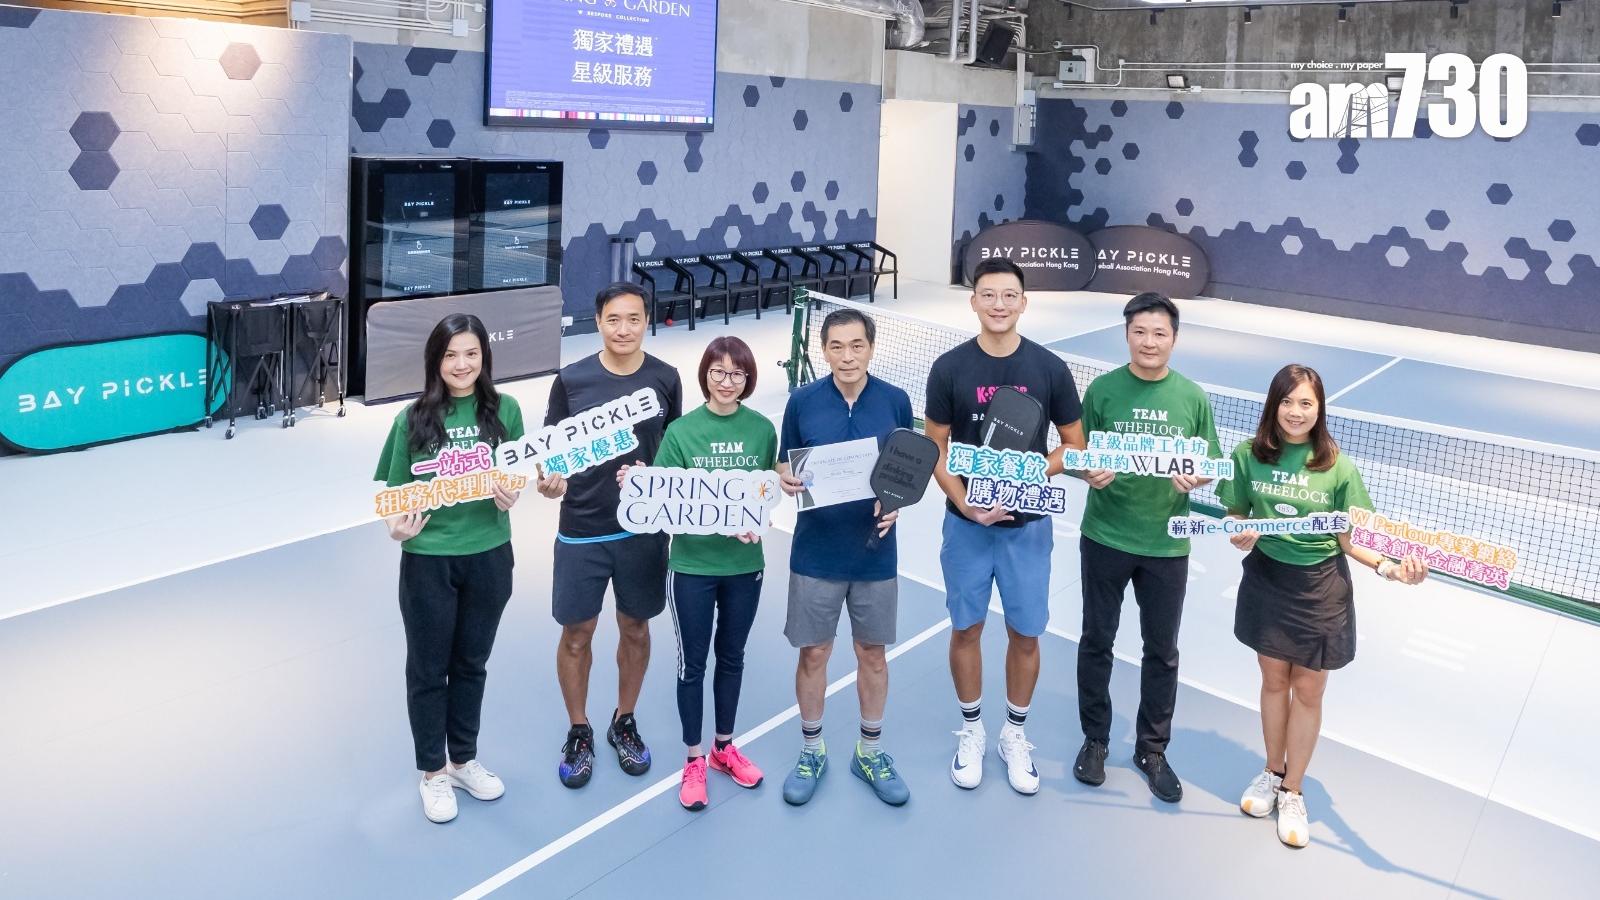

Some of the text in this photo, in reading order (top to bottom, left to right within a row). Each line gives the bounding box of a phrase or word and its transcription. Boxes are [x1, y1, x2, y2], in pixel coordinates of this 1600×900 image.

[624, 0, 691, 17] GARDEN
[615, 14, 650, 23] COLLECTION
[572, 28, 654, 57] 獨家禮遇
[571, 61, 653, 88] 星級服務
[982, 247, 1014, 259] BAY
[1097, 249, 1120, 261] AY
[1046, 261, 1062, 270] Hong
[1063, 261, 1079, 270] Kong
[1115, 263, 1152, 273] Association
[1153, 266, 1171, 277] Hong
[1172, 268, 1190, 279] Kong
[18, 385, 85, 413] BAY
[1132, 408, 1168, 421] TEAM
[1114, 421, 1185, 437] WHEELOCK
[504, 434, 552, 465] BAY
[544, 427, 635, 475] 獨家優惠
[710, 442, 744, 454] TEAM
[1090, 433, 1206, 456] 星級品牌工作坊
[414, 446, 491, 476] 一站式
[692, 455, 759, 468] WHEELOCK
[950, 445, 1047, 483] 獨家餐飲
[1199, 460, 1233, 478] 空間
[1272, 470, 1310, 486] TEAM
[629, 475, 745, 501] SPRING
[969, 477, 1065, 514] 購物禮遇
[1251, 480, 1329, 504] WHEELOCK
[625, 502, 763, 527] GARDEN
[1278, 505, 1294, 514] 1857
[1350, 507, 1369, 524] W
